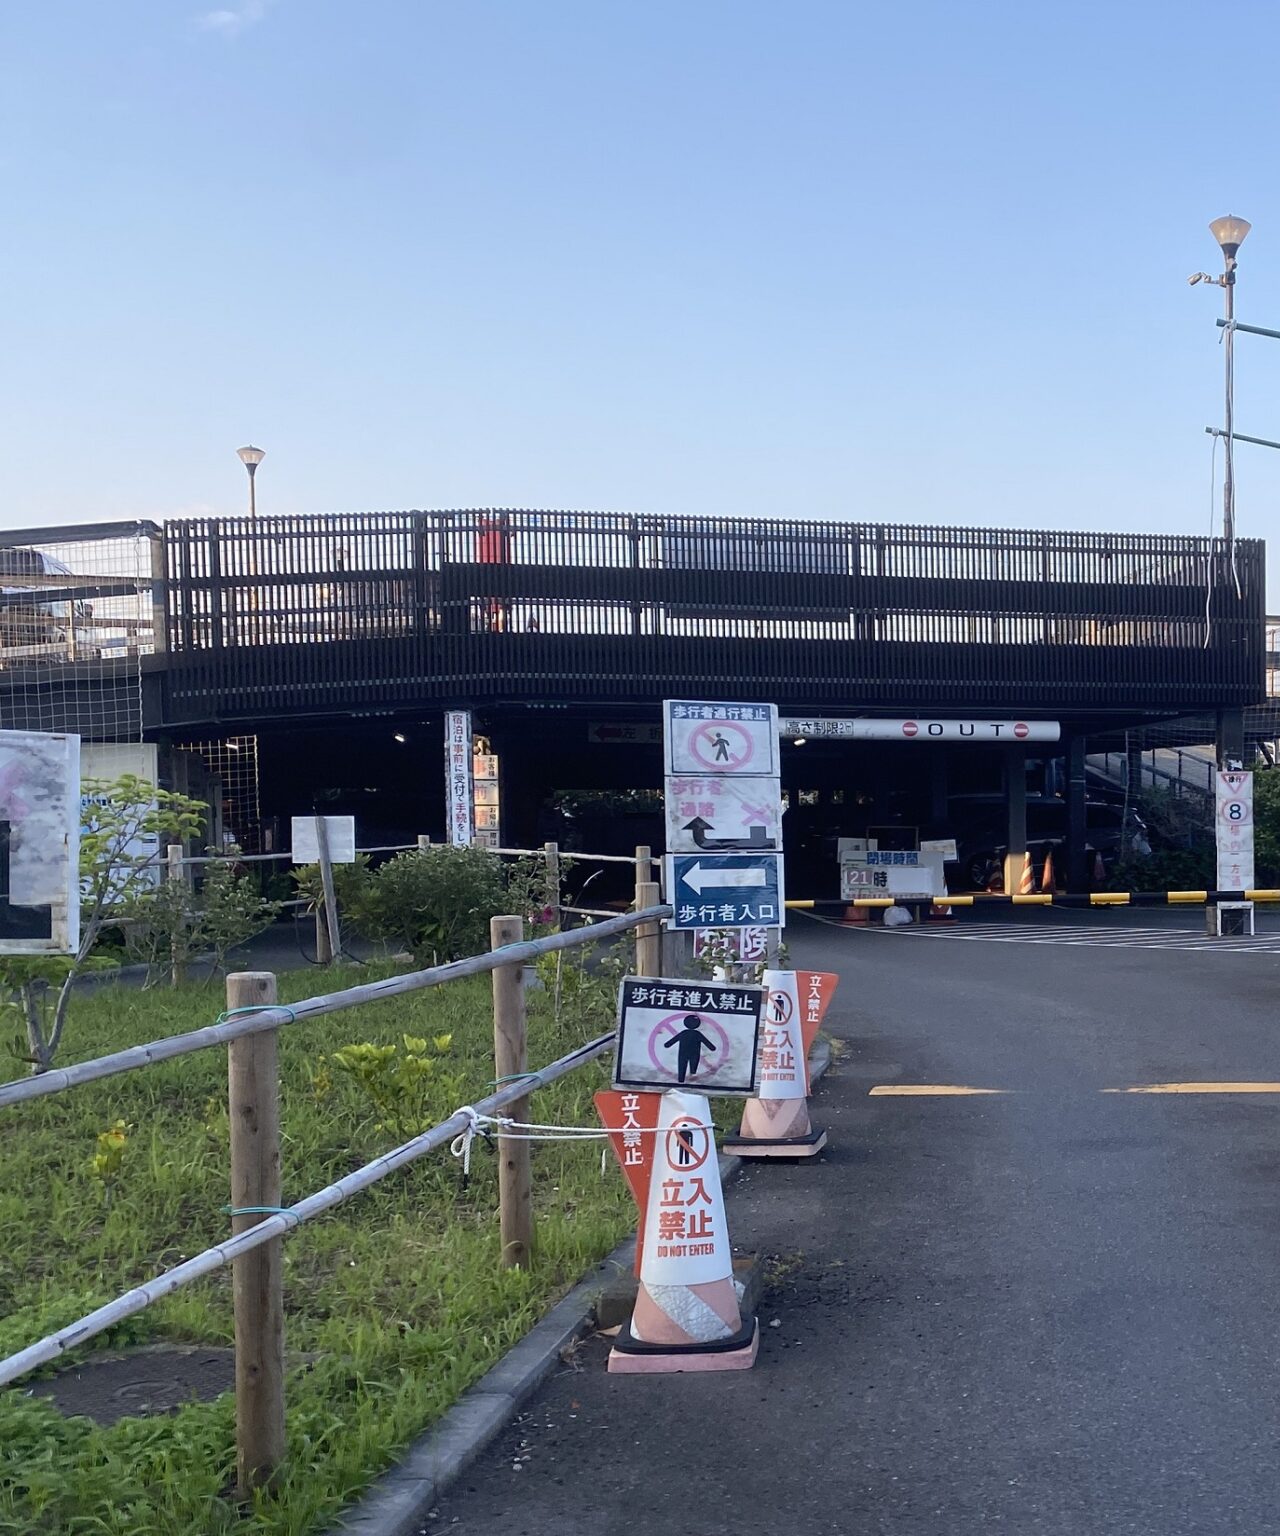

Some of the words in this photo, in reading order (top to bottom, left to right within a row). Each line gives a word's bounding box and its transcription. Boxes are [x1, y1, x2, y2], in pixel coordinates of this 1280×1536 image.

[673, 705, 767, 721] 歩行者通行禁止
[928, 723, 1004, 736] OUT
[672, 779, 722, 796] 歩行者
[680, 802, 716, 817] 通路
[1229, 803, 1241, 820] 8
[850, 871, 888, 887] 21時
[678, 904, 775, 922] 歩行者入口
[632, 987, 754, 1011] 歩行者進入禁止
[806, 975, 822, 1023] 立入禁止
[763, 1030, 794, 1048] 立入
[761, 1051, 795, 1070] 禁止
[621, 1093, 644, 1166] 立入禁止
[659, 1177, 713, 1207] 立入
[658, 1210, 715, 1241] 禁止
[657, 1245, 668, 1258] DO
[669, 1244, 688, 1257] NOT
[689, 1243, 715, 1256] ENTER
